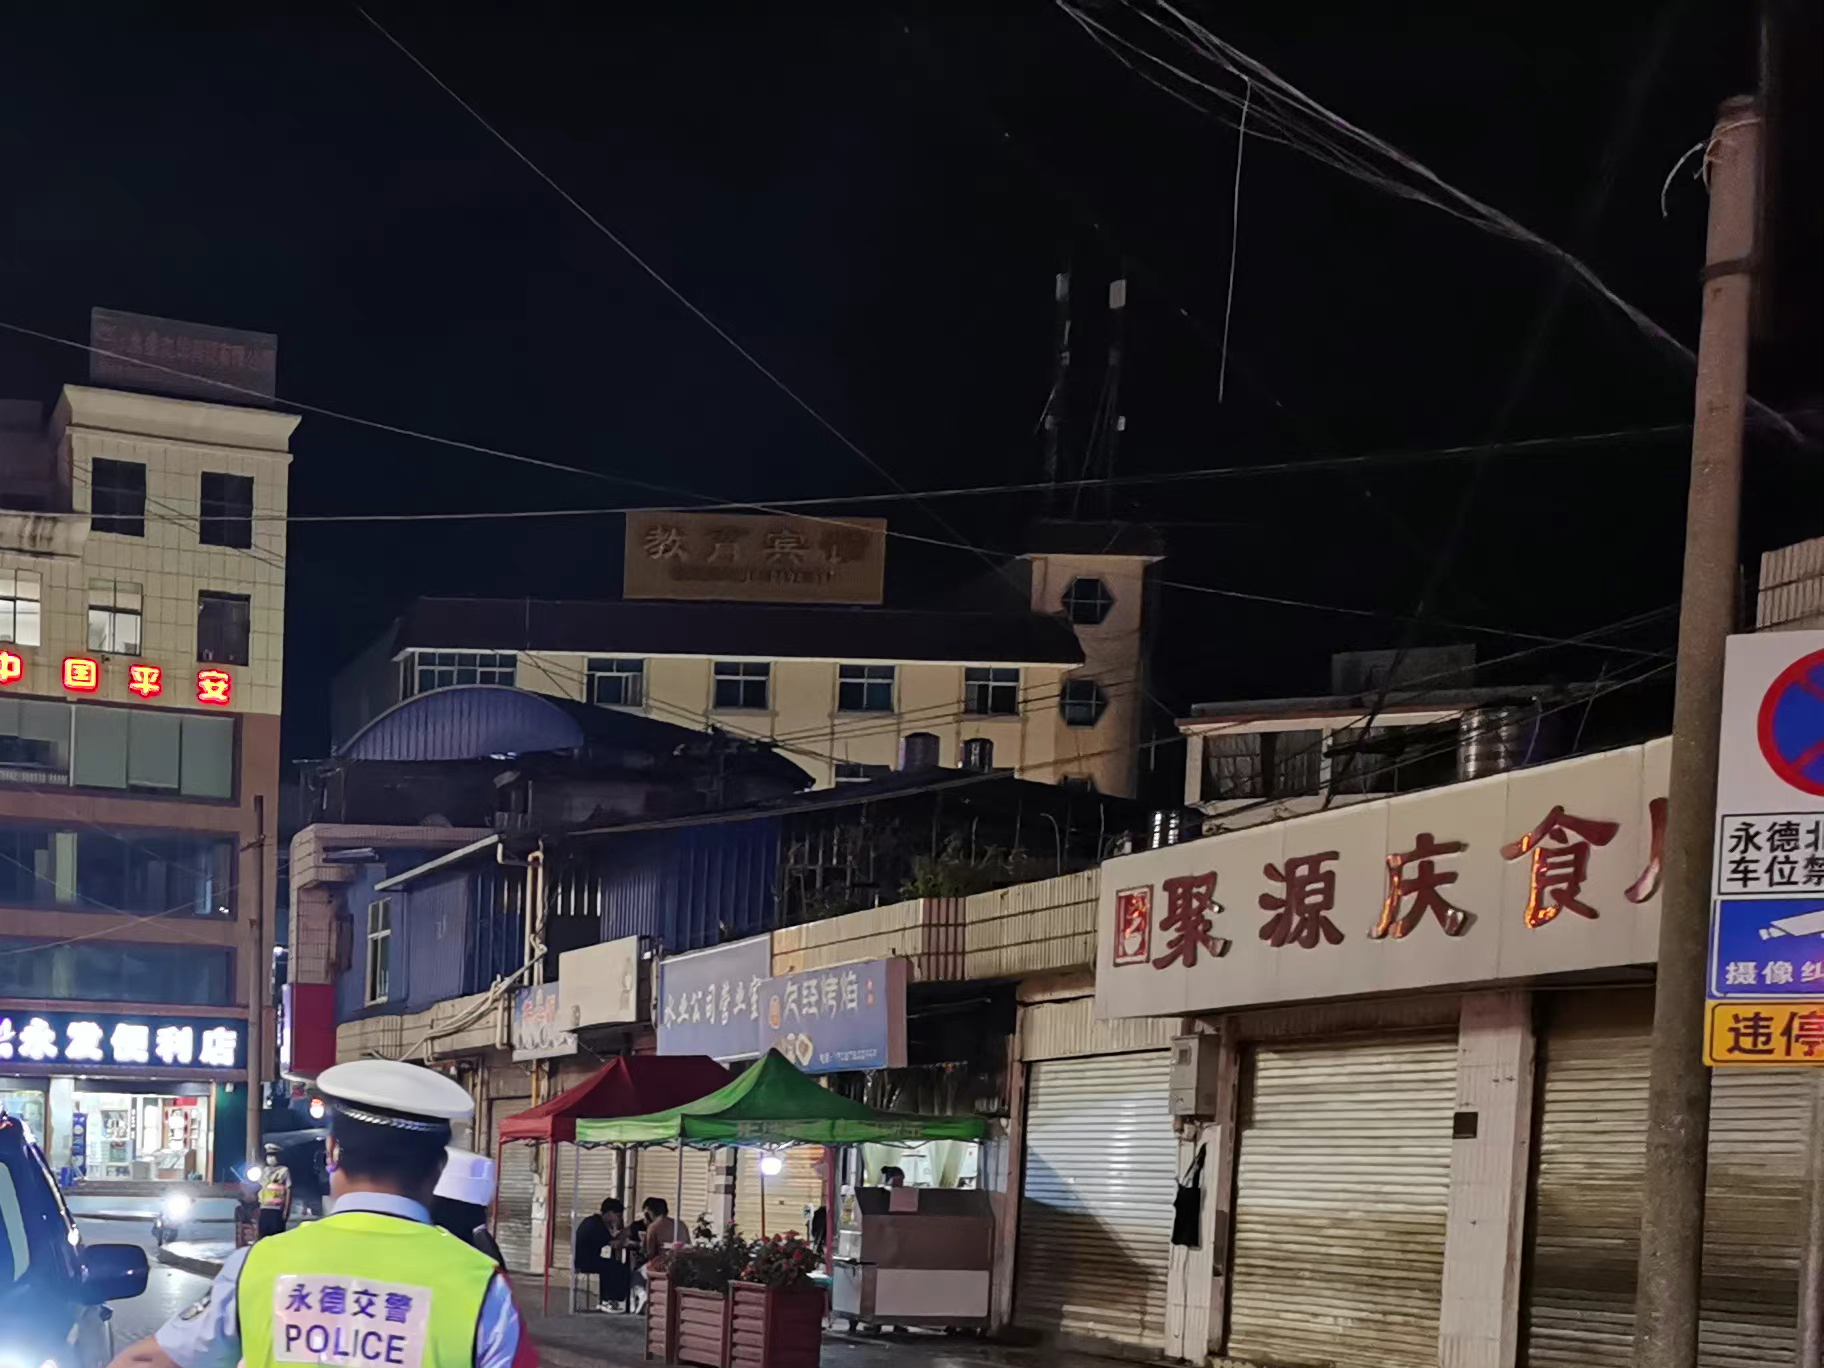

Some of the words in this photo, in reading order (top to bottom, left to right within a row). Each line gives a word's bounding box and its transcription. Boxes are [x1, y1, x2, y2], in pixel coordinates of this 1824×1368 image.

[1152, 797, 1668, 970] 聚源庆食
[1727, 1011, 1824, 1057] 违停
[284, 1283, 413, 1324] 永德交警
[285, 1324, 407, 1364] POLICE
